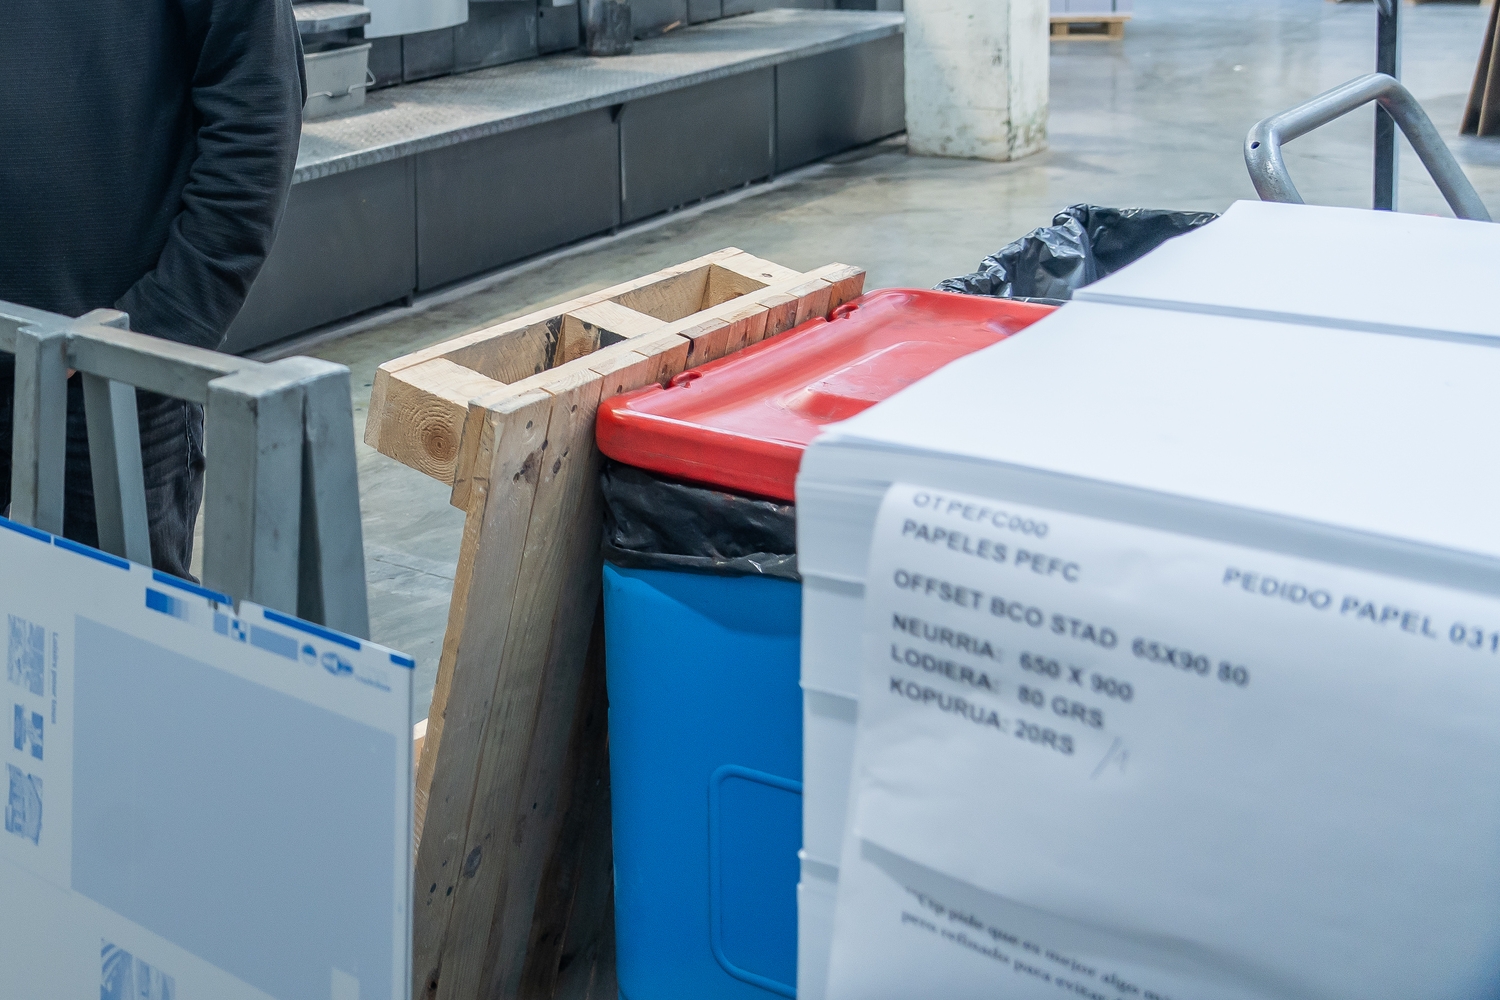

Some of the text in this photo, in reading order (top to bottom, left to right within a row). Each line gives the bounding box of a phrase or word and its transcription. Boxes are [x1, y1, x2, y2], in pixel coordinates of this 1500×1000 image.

[902, 517, 1081, 584] PAPELES PEFC
[893, 567, 1250, 688] OFFSET BCO STAD 65X90 80
[1222, 566, 1332, 610] PEDIDO
[1340, 594, 1437, 640] PAPEL
[1018, 650, 1062, 680] 650
[1089, 672, 1135, 703] 900
[1017, 683, 1046, 710] 80
[1050, 694, 1106, 731] GRS
[1013, 718, 1076, 757] 20RS
